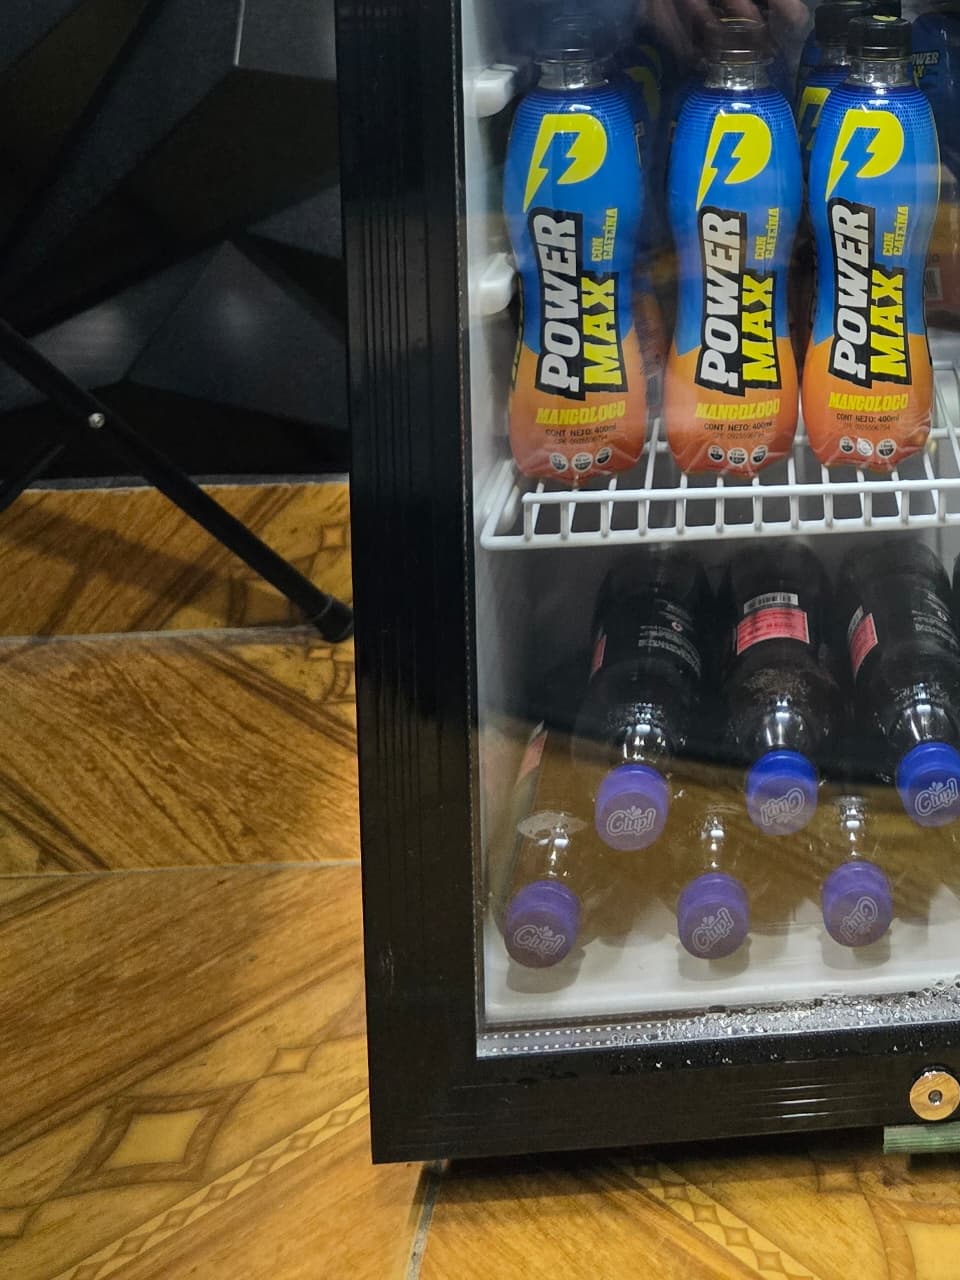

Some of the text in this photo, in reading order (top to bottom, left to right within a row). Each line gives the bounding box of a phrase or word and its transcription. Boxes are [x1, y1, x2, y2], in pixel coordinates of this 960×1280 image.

[592, 238, 603, 261] CON
[755, 236, 766, 259] CON
[832, 204, 868, 380] POWER
[882, 232, 895, 256] CON
[533, 214, 581, 392] POWER
[581, 277, 622, 385] MAX
[700, 212, 740, 388] POWER
[741, 274, 778, 382] MAX
[870, 269, 907, 377] MAX
